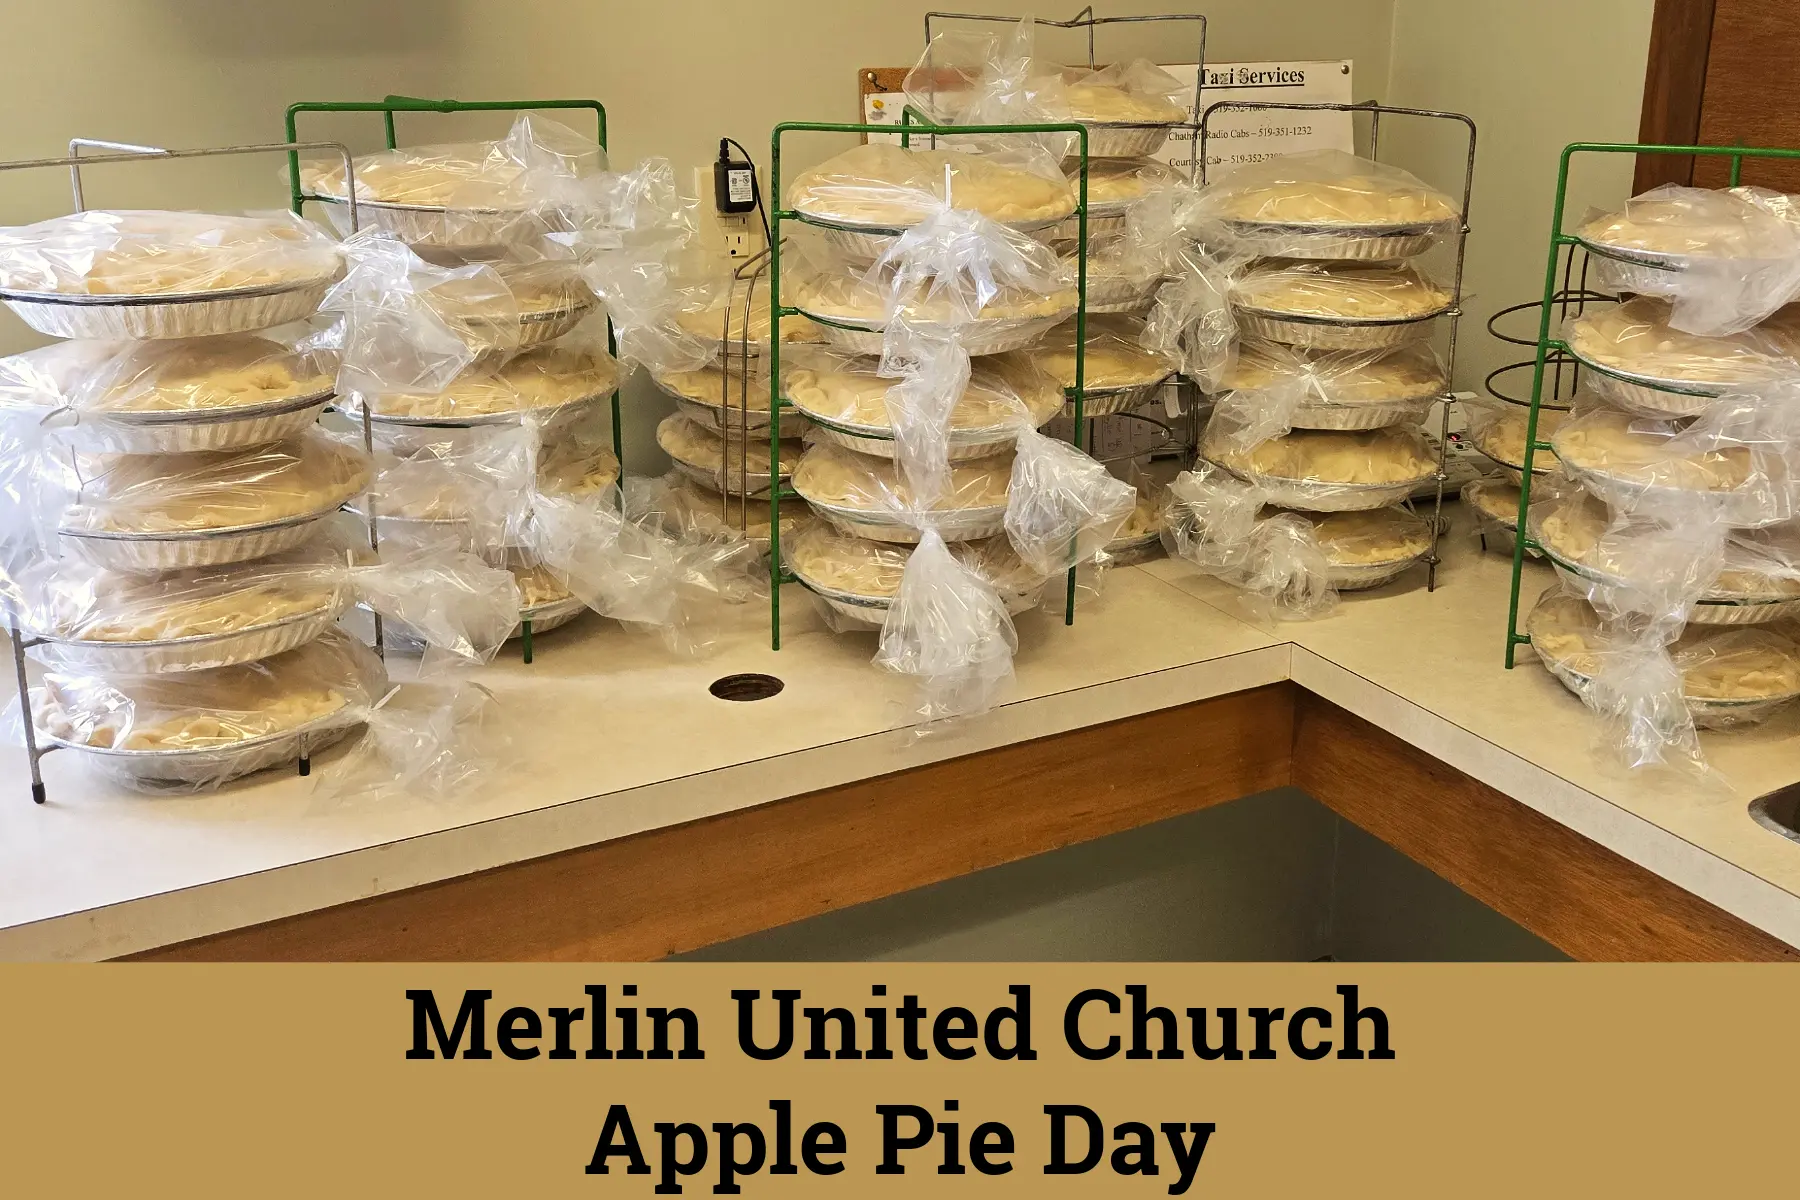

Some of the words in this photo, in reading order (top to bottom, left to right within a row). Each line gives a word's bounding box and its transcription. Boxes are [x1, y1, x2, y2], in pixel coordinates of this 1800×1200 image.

[1239, 66, 1305, 85] Services
[1206, 128, 1229, 139] Radio
[1230, 128, 1250, 139] Cabs
[1258, 126, 1312, 137] 519-351-1232
[1206, 155, 1222, 165] Cab
